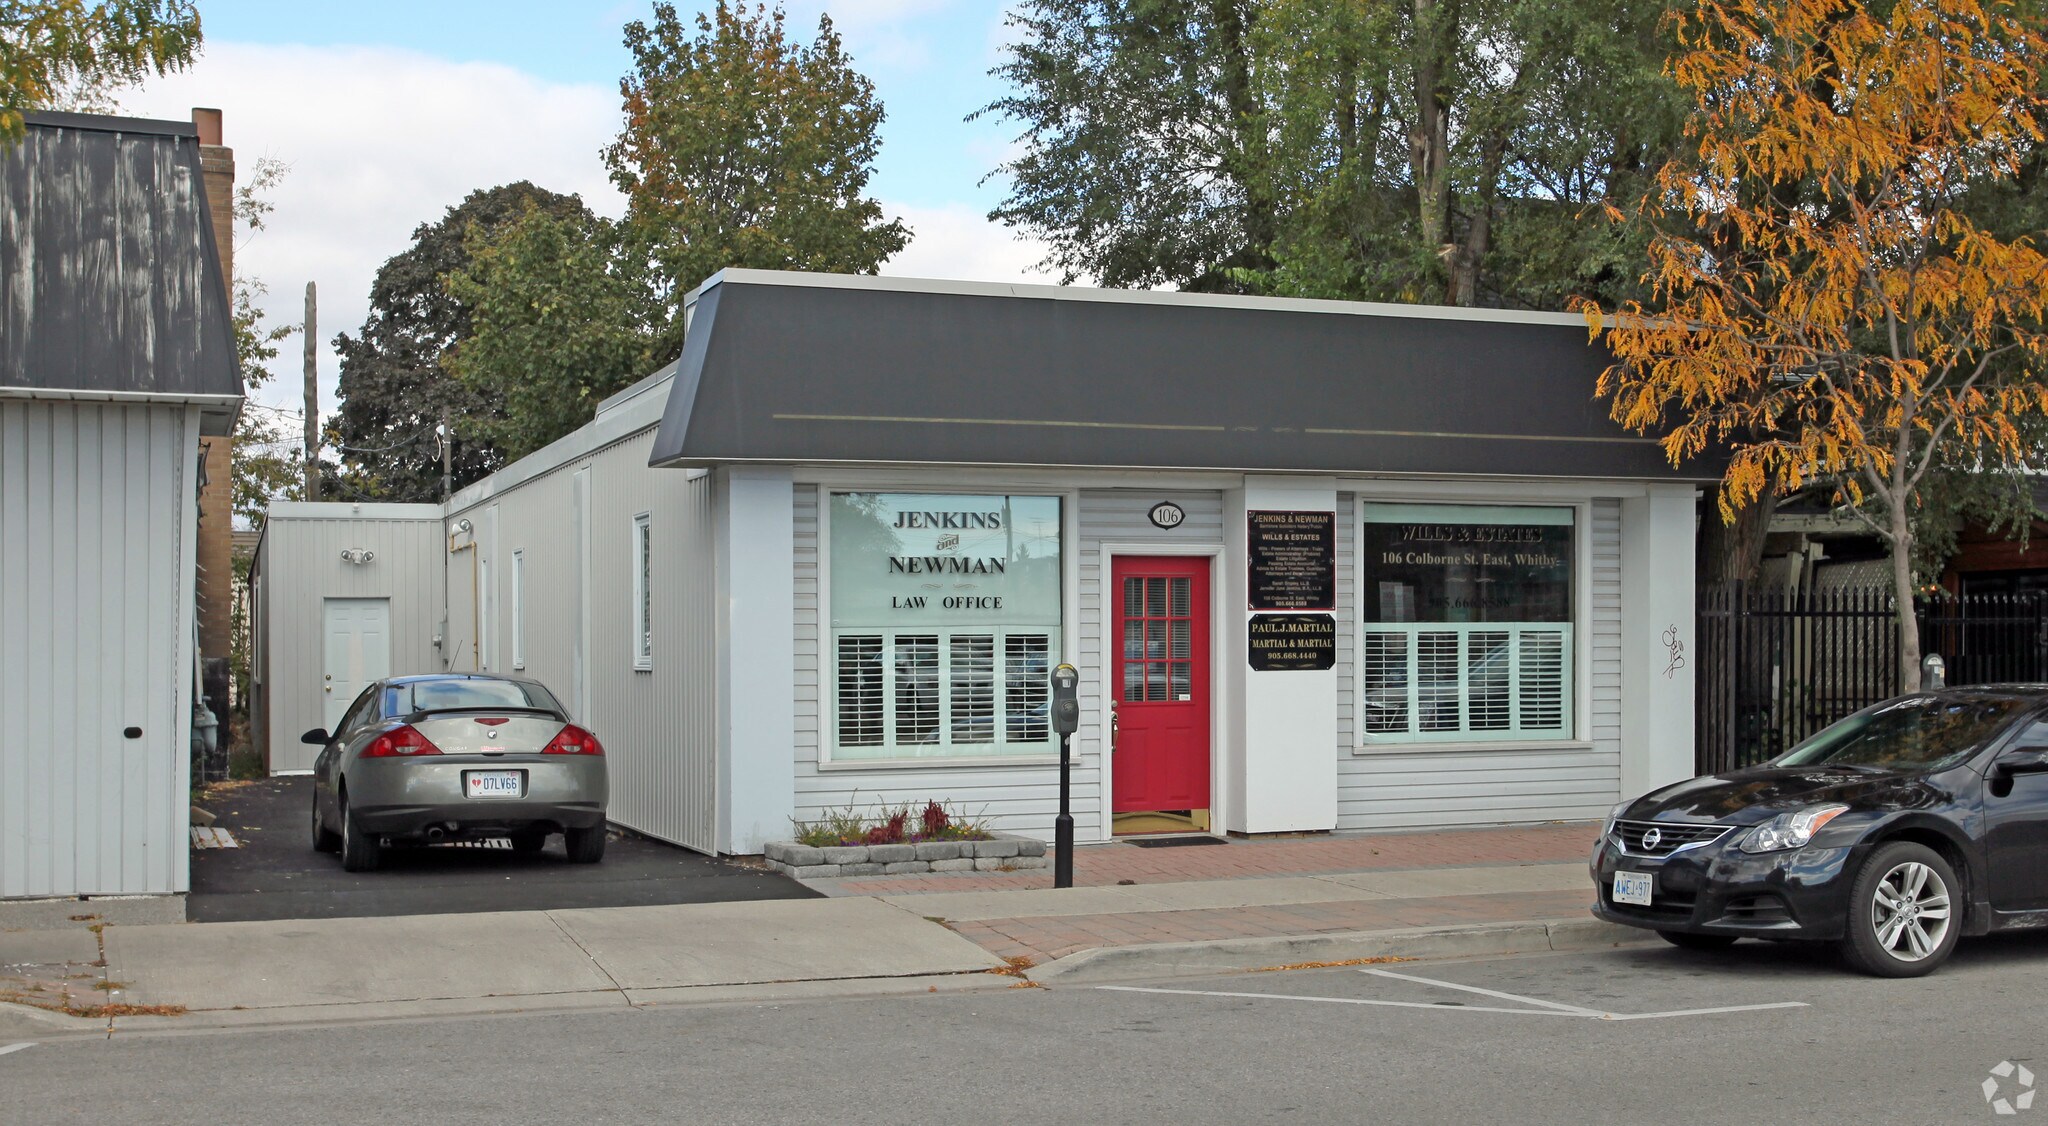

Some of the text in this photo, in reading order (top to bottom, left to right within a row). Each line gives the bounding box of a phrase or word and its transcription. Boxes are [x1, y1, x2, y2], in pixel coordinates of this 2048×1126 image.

[893, 511, 1001, 529] JENKINS
[1158, 508, 1179, 523] 106
[1254, 514, 1329, 524] JENKINS & NEWMAN
[1262, 533, 1320, 541] WILLS & ESTATES
[1401, 525, 1544, 543] WILLS & ESTATES
[936, 533, 960, 551] and
[888, 556, 1007, 574] NEWMAN
[1382, 551, 1558, 569] 106 Colborne St. East, Whitby
[892, 596, 1003, 609] LAW OFFICE
[1251, 623, 1333, 633] PAUL.J.MARTIAL
[1252, 639, 1332, 648] MARTIAL & MARTIAL
[1267, 652, 1317, 660] 905.668.4440
[483, 777, 517, 790] 07LV66
